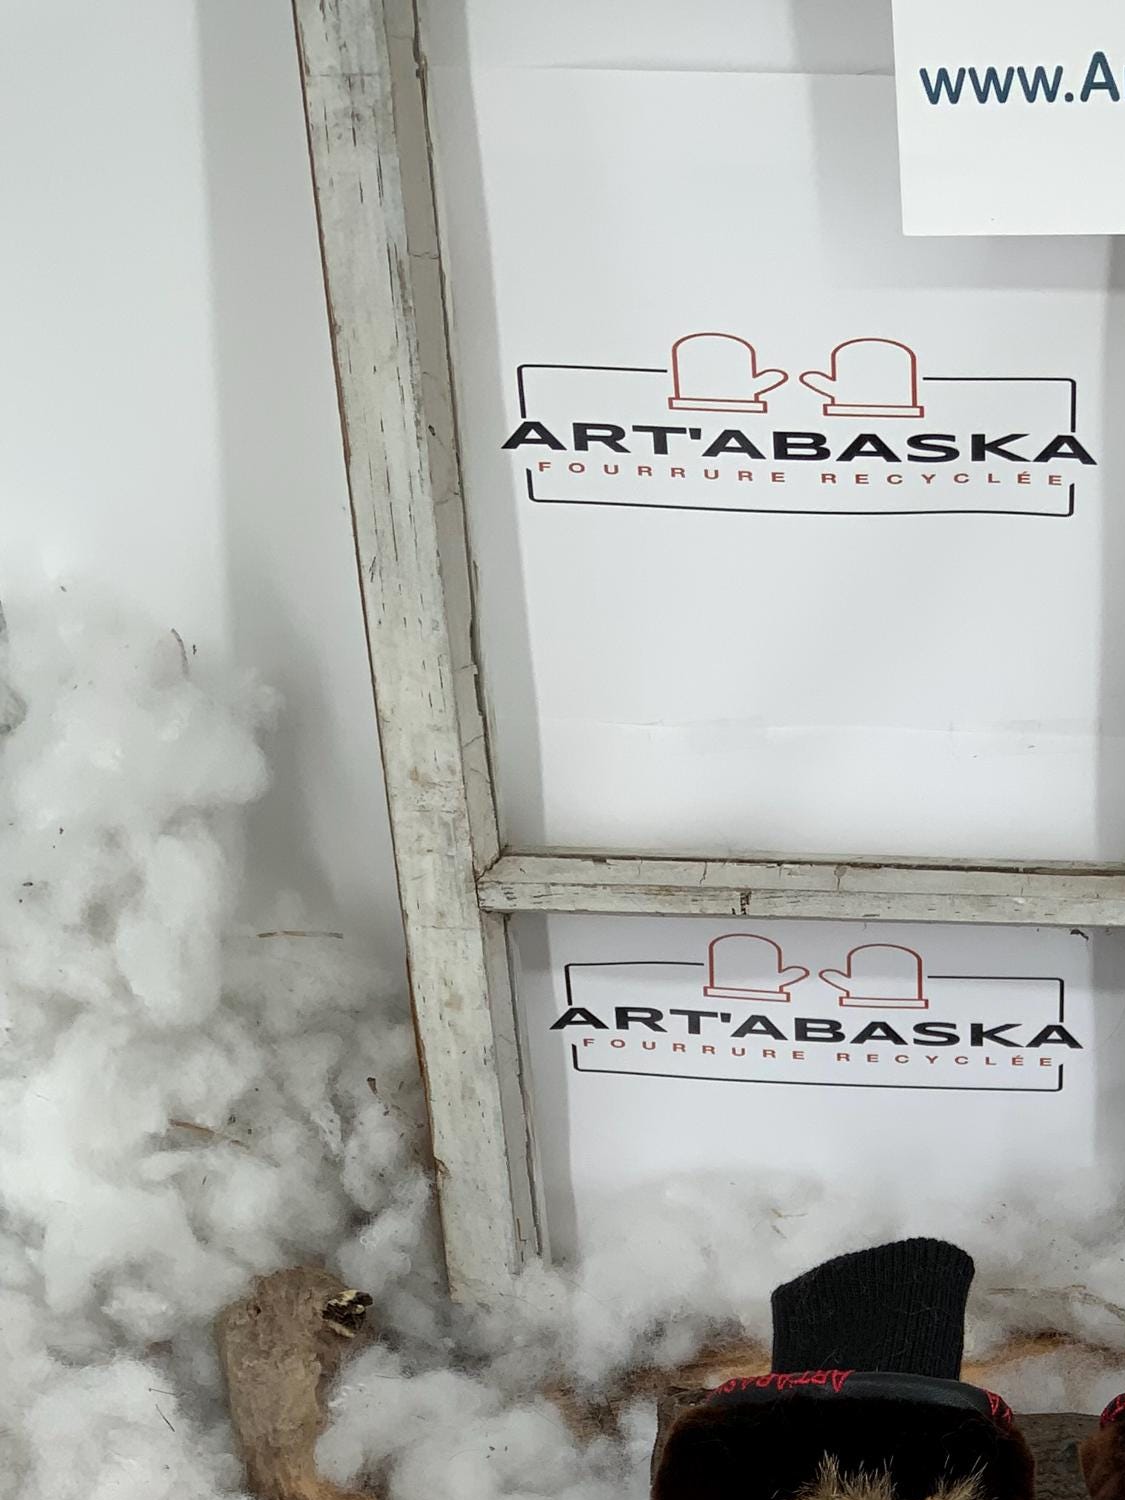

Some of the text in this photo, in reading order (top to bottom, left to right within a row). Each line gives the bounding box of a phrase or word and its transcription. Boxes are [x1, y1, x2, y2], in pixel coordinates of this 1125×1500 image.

[501, 420, 1098, 466] ART'ABASKA
[538, 461, 1063, 486] FOURRURE RECYCLÉE
[549, 1006, 1084, 1050] ART'ABASKA
[583, 1037, 1053, 1068] FOURRURE RECYCLÉE
